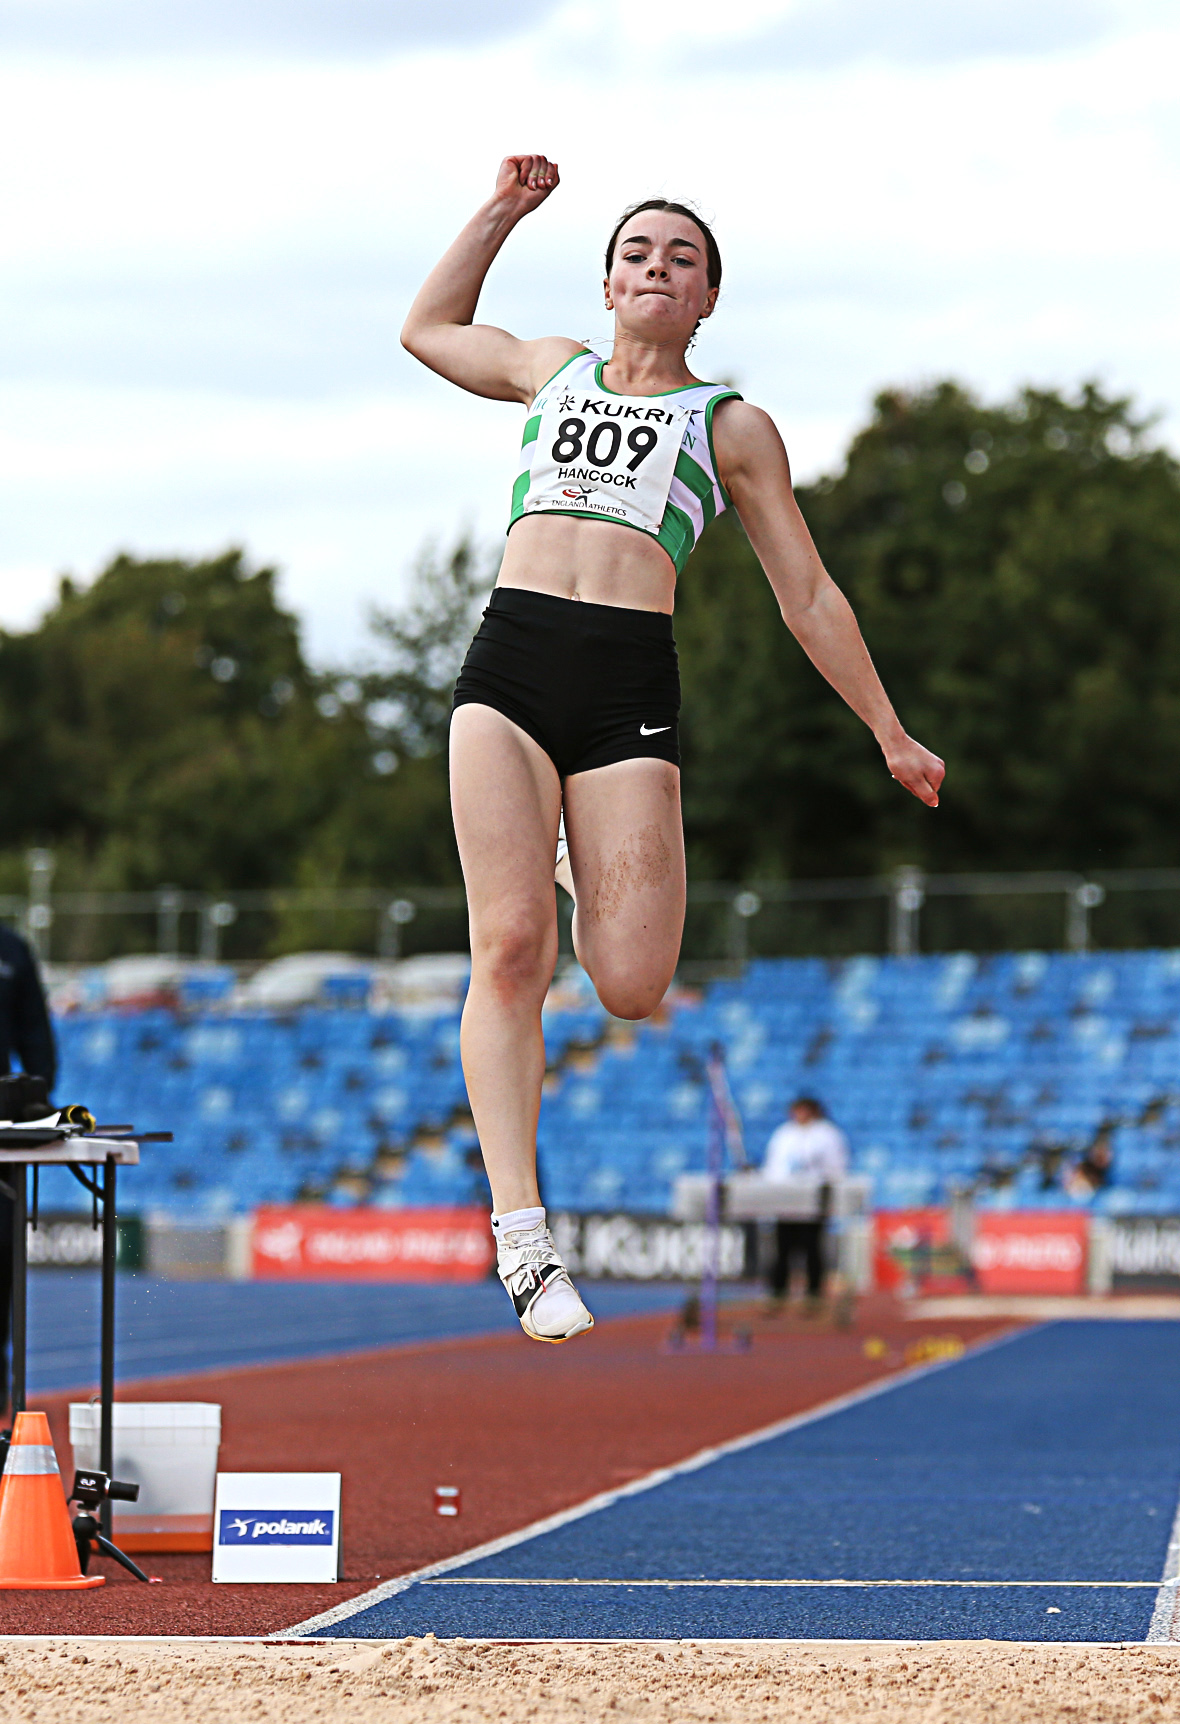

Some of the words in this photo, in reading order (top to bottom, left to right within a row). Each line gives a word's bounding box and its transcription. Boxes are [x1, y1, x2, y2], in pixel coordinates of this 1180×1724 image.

[581, 399, 674, 426] KUKRI
[552, 417, 658, 472] 809
[557, 467, 638, 490] HANCOCK
[551, 499, 585, 508] ENGLAND
[588, 503, 627, 517] ATHLETICS
[519, 1249, 555, 1263] NIKE
[251, 1518, 327, 1538] polanik
